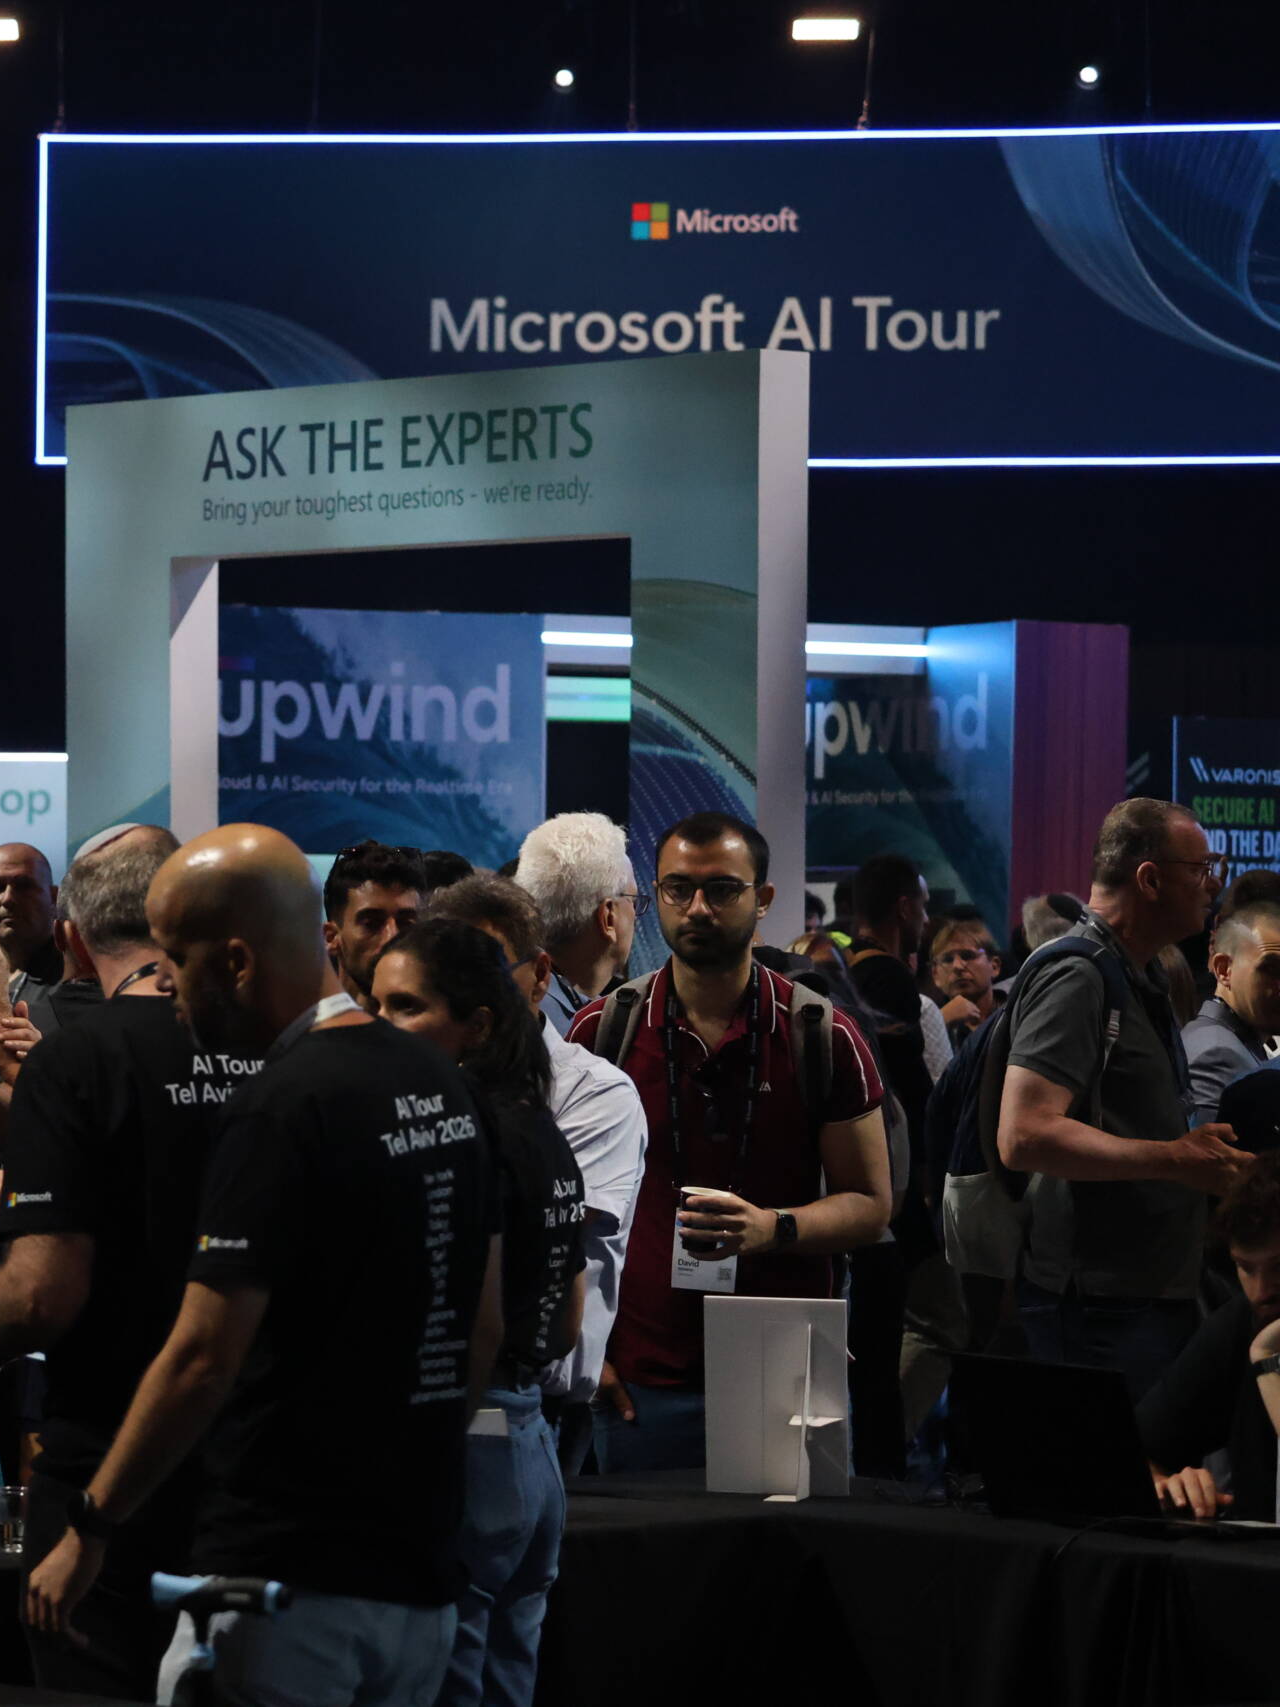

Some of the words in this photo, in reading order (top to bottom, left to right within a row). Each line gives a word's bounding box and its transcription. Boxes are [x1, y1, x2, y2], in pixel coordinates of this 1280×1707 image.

[676, 207, 800, 234] Microsoft
[429, 294, 745, 354] Microsoft
[765, 296, 834, 352] AI
[851, 297, 1001, 352] Tour
[203, 425, 286, 482] ASK
[299, 419, 383, 474] THE
[400, 403, 593, 468] EXPERTS
[203, 500, 247, 526] Bring
[252, 498, 289, 526] your
[295, 488, 373, 524] toughest
[377, 483, 464, 517] questions
[482, 479, 532, 505] we're
[536, 476, 593, 505] ready.
[805, 672, 988, 779] pwind
[220, 775, 251, 790] oud
[255, 774, 267, 791] &
[271, 775, 287, 791] AI
[291, 776, 357, 795] Security
[360, 776, 382, 793] for
[385, 777, 411, 794] the
[415, 778, 484, 795] Realtime
[1193, 797, 1254, 825] SECURE
[1259, 798, 1275, 825] AI
[1230, 829, 1260, 857] THE
[193, 1054, 214, 1075] AI
[215, 1054, 265, 1075] Tour
[165, 1081, 198, 1105] Tel
[202, 1082, 233, 1103] Avi
[395, 1096, 412, 1119] AI
[407, 1093, 444, 1117] Tour
[380, 1128, 410, 1156] Tel
[409, 1124, 436, 1150] Aviv
[436, 1114, 476, 1144] 2026
[678, 1258, 700, 1268] David
